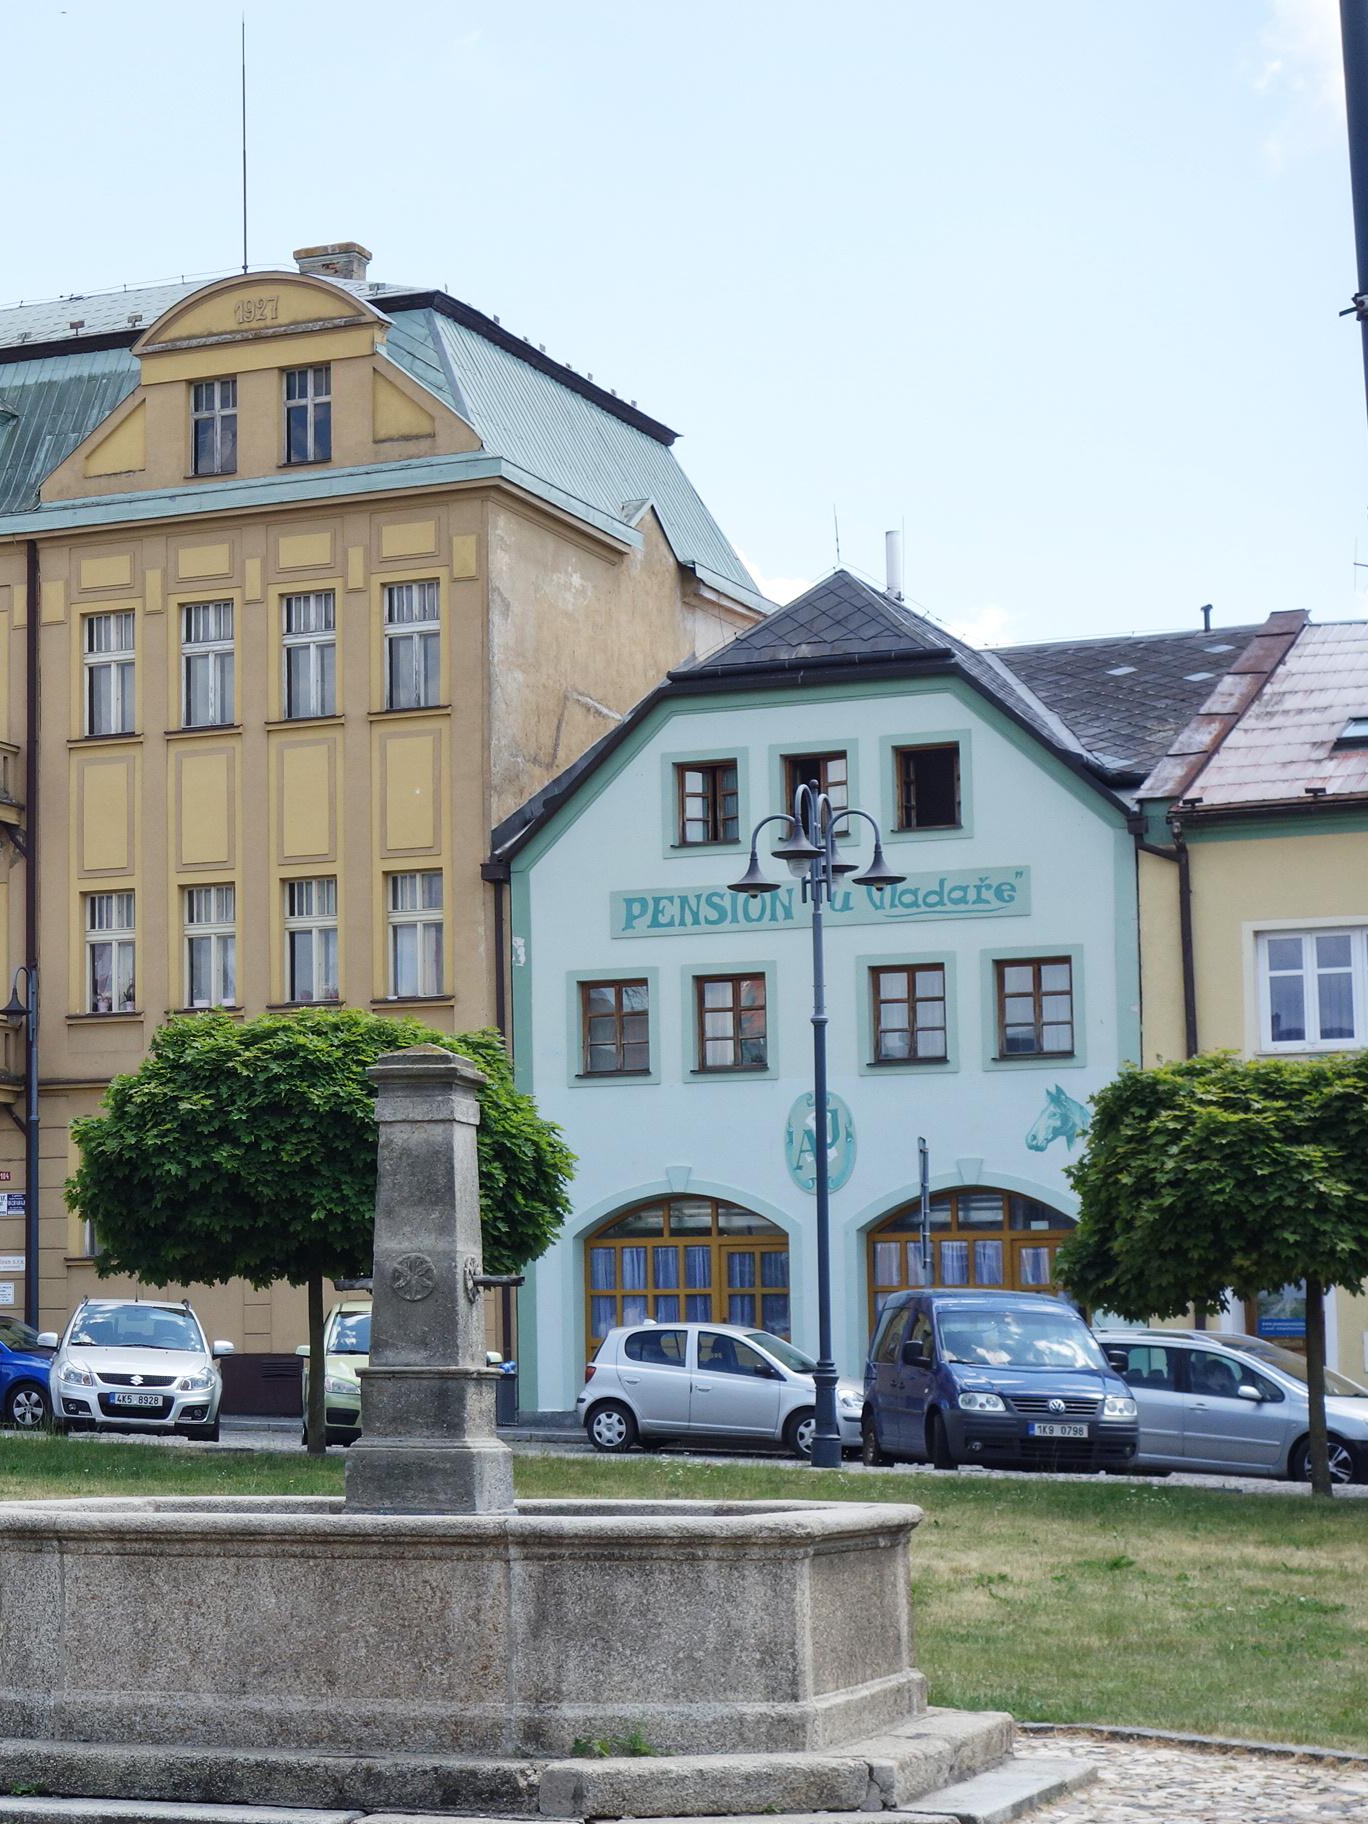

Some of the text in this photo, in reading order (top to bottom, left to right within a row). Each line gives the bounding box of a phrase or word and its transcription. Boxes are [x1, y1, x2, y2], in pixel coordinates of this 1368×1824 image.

[234, 295, 280, 324] 1927
[622, 888, 794, 931] PENSION
[117, 1395, 159, 1405] 4K5 8928
[1037, 1425, 1084, 1436] 1K9 0798
